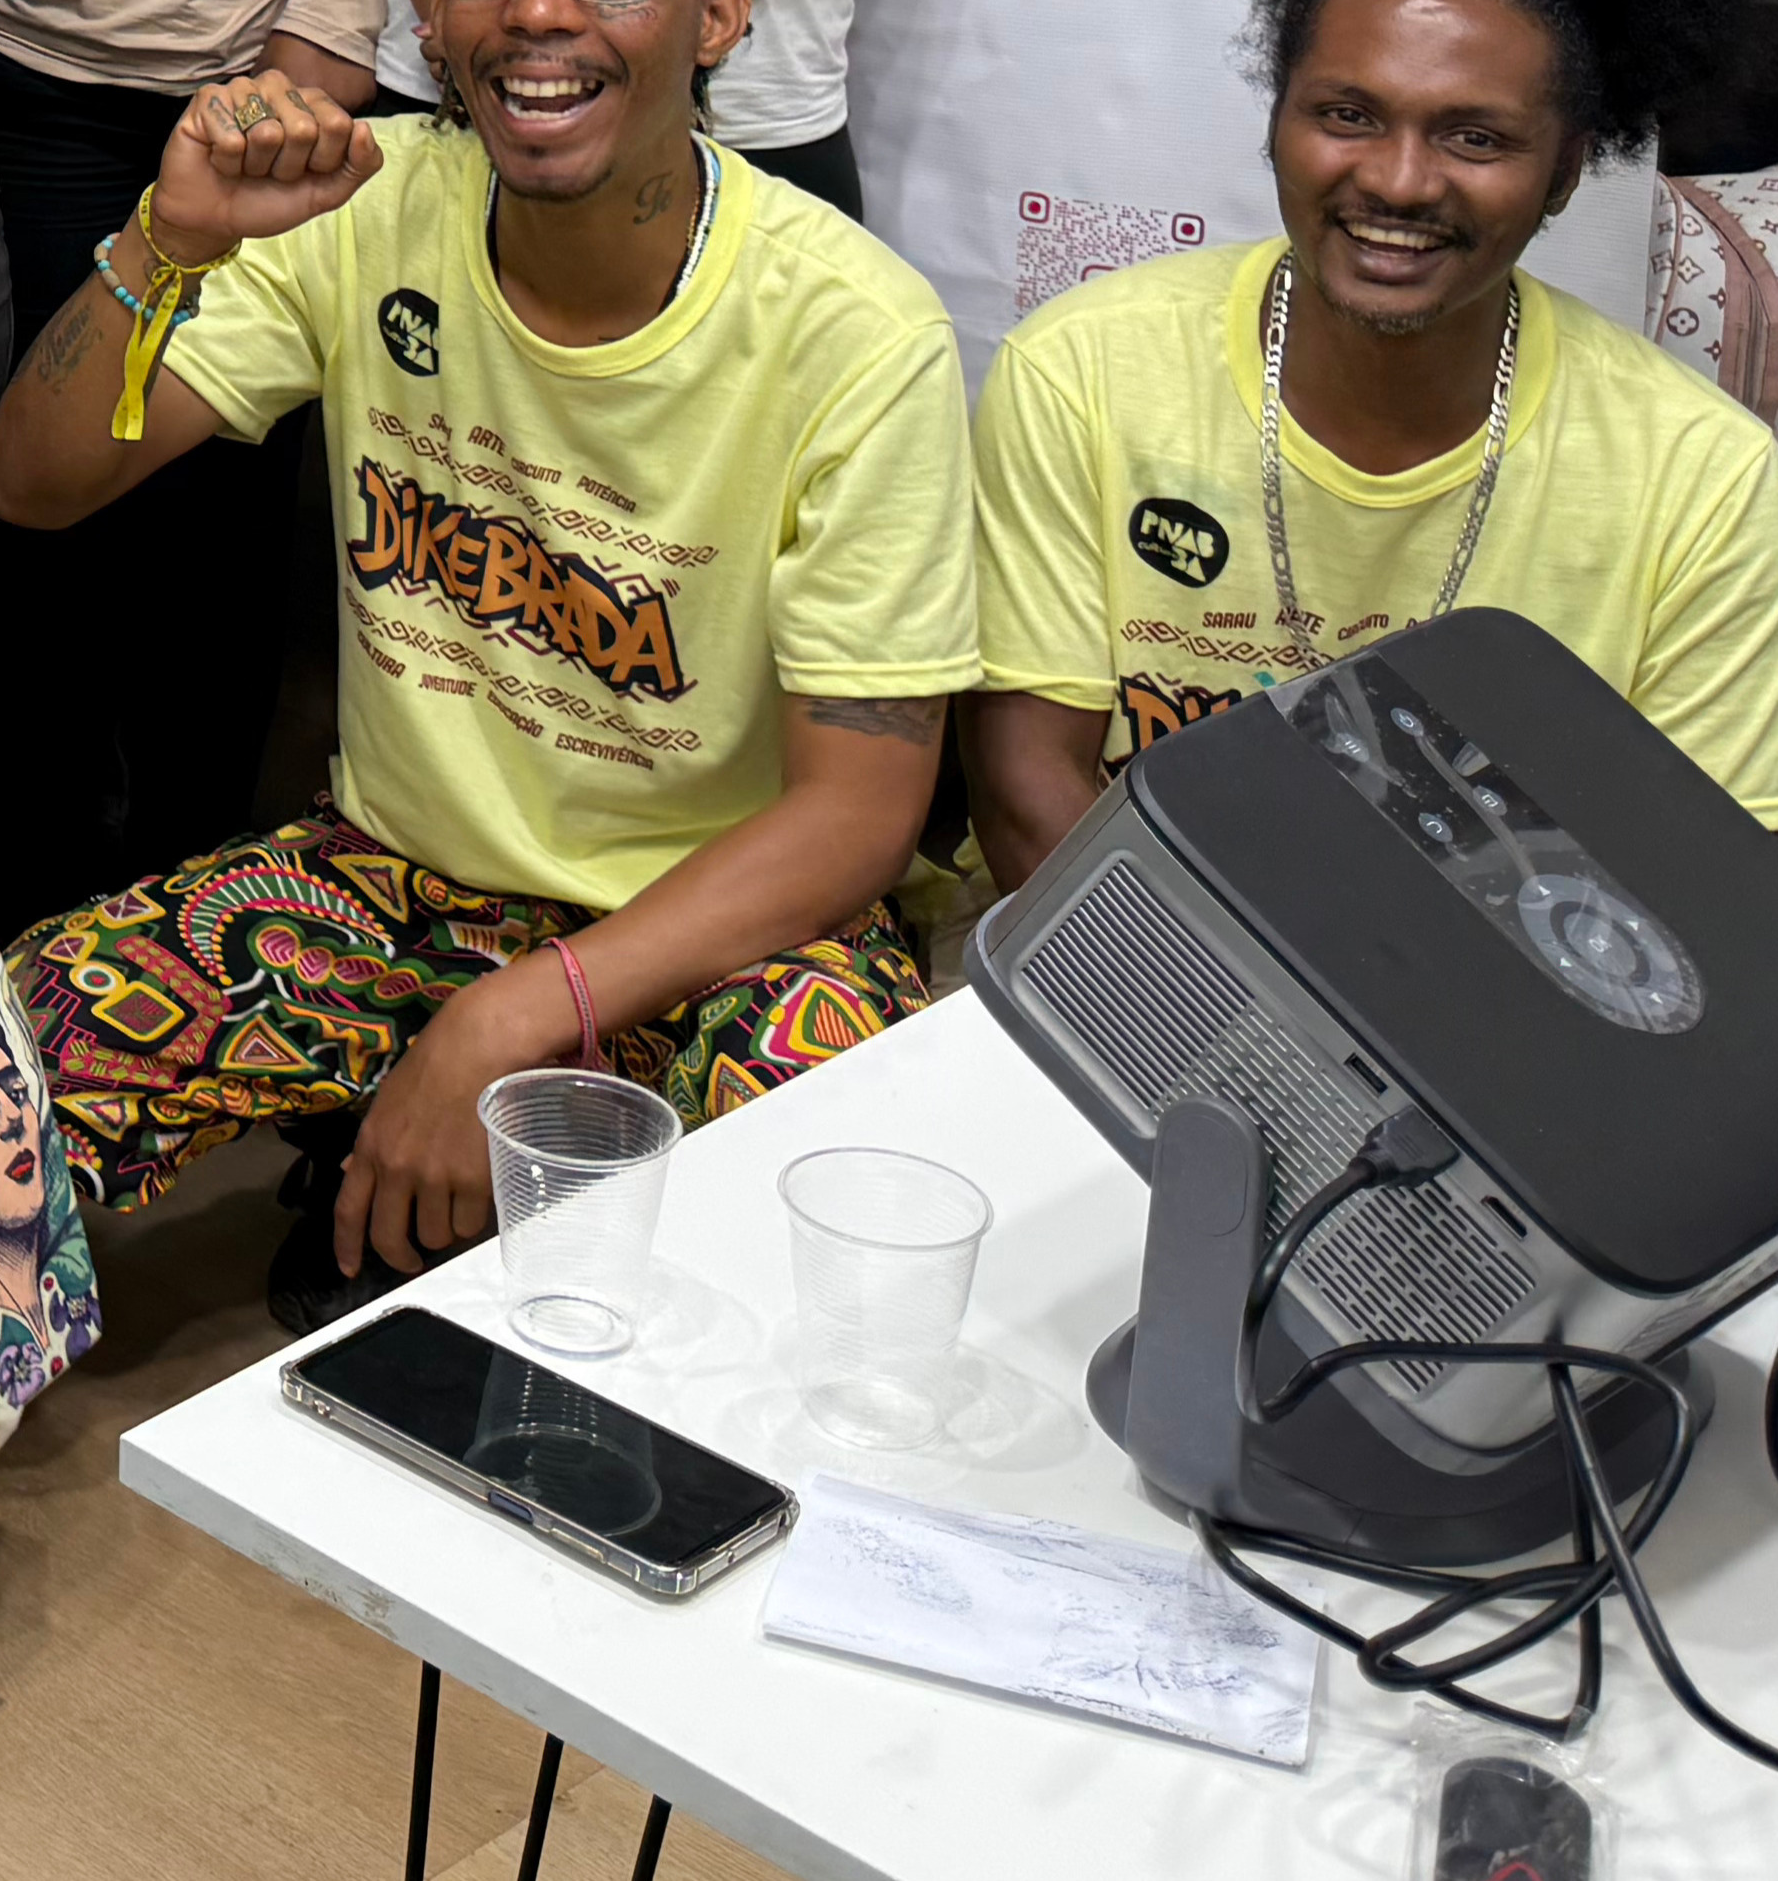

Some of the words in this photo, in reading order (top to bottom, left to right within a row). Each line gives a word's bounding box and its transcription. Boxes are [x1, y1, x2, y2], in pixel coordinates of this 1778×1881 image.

[467, 425, 508, 458] ARTE
[576, 475, 637, 513] POTÊNCIA
[1141, 509, 1214, 558] PNAB
[1202, 611, 1256, 629] SARAU
